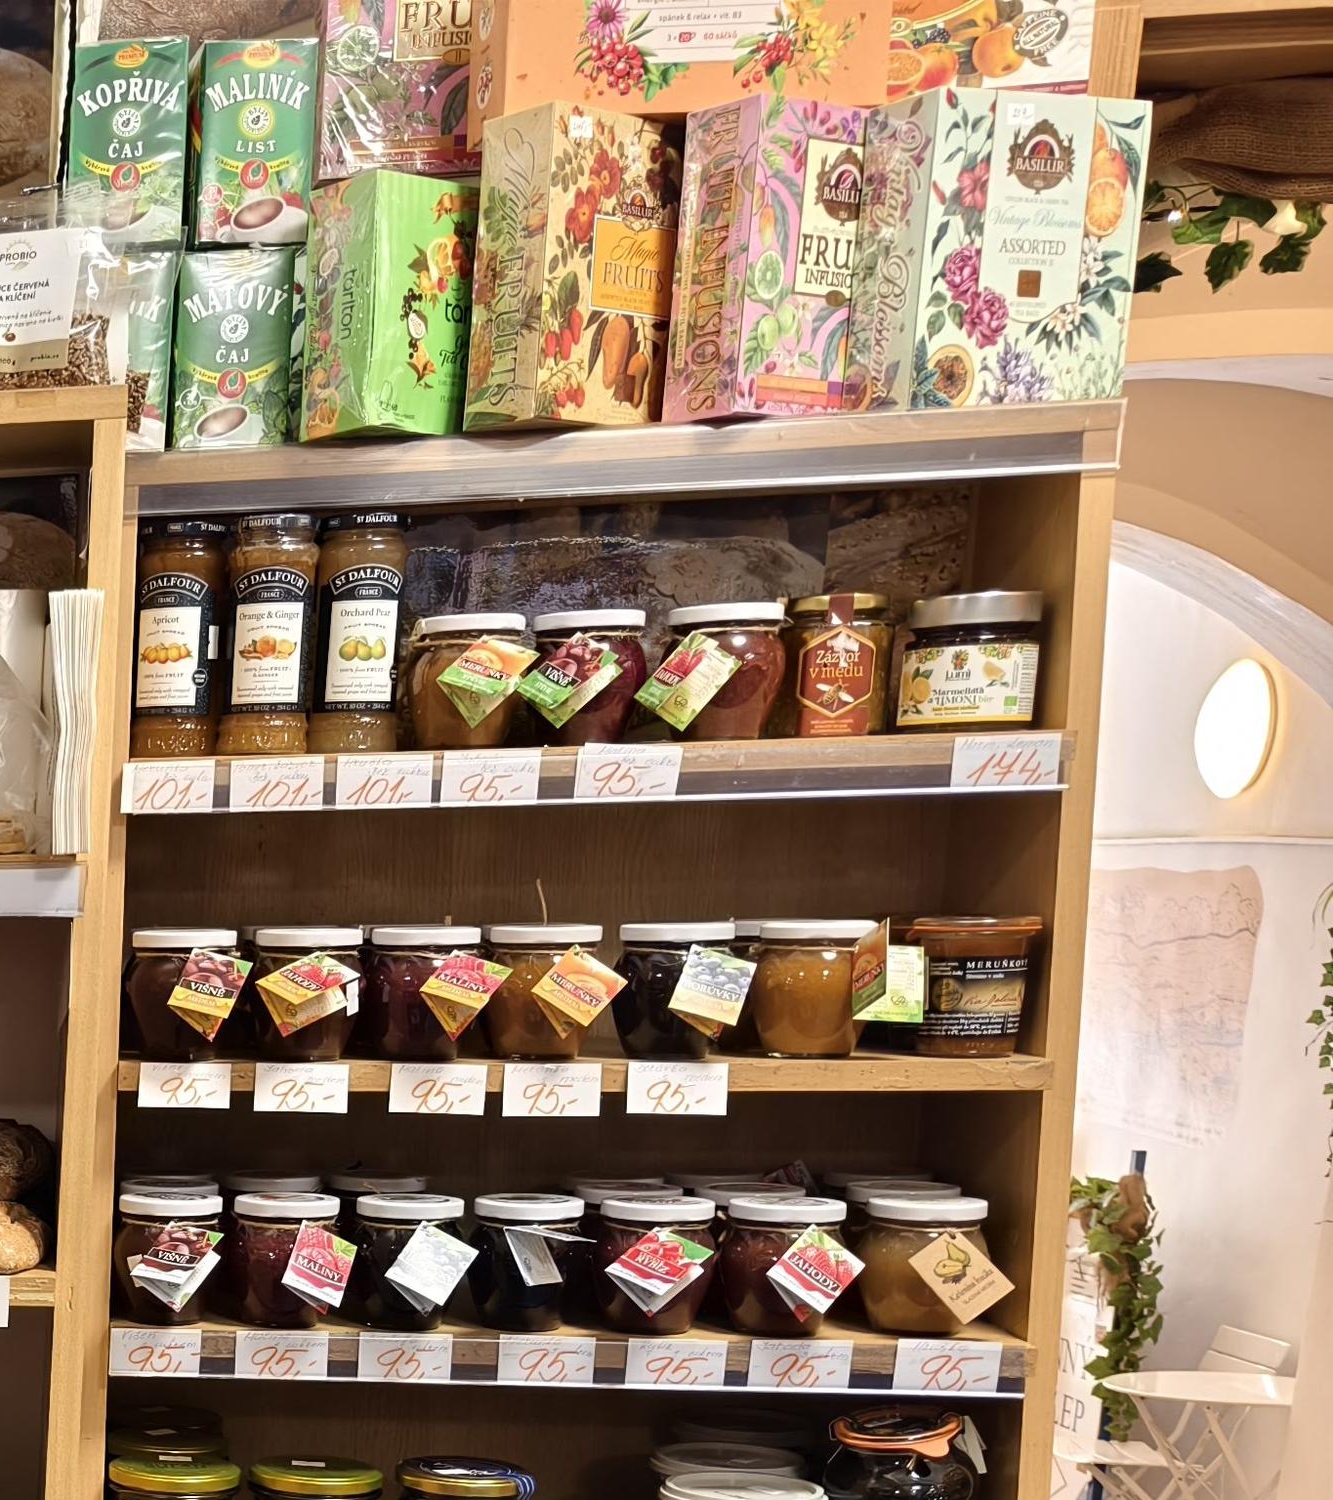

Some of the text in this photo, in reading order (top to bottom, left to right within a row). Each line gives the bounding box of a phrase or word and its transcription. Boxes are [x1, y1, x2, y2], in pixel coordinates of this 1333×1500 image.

[77, 71, 184, 117] KOPŘIVA
[206, 70, 310, 111] MALINÍK
[236, 141, 277, 154] LIST
[0, 249, 37, 262] PROBIO
[999, 238, 1066, 256] ASSORTED
[14, 278, 50, 291] ČERVENÁ
[216, 345, 249, 363] ČAJ
[349, 567, 401, 588] DALFOUR
[357, 588, 380, 597] FRANCE
[152, 614, 179, 626] Apricot
[239, 610, 265, 622] Orange
[276, 610, 299, 623] Ginger
[340, 607, 391, 618] Orchard Pear
[816, 649, 861, 665] Zázvor
[189, 980, 226, 998] VIŠNĚ
[280, 968, 321, 992] JAHODY
[438, 973, 487, 993] MALINY
[295, 1255, 342, 1283] MALINY
